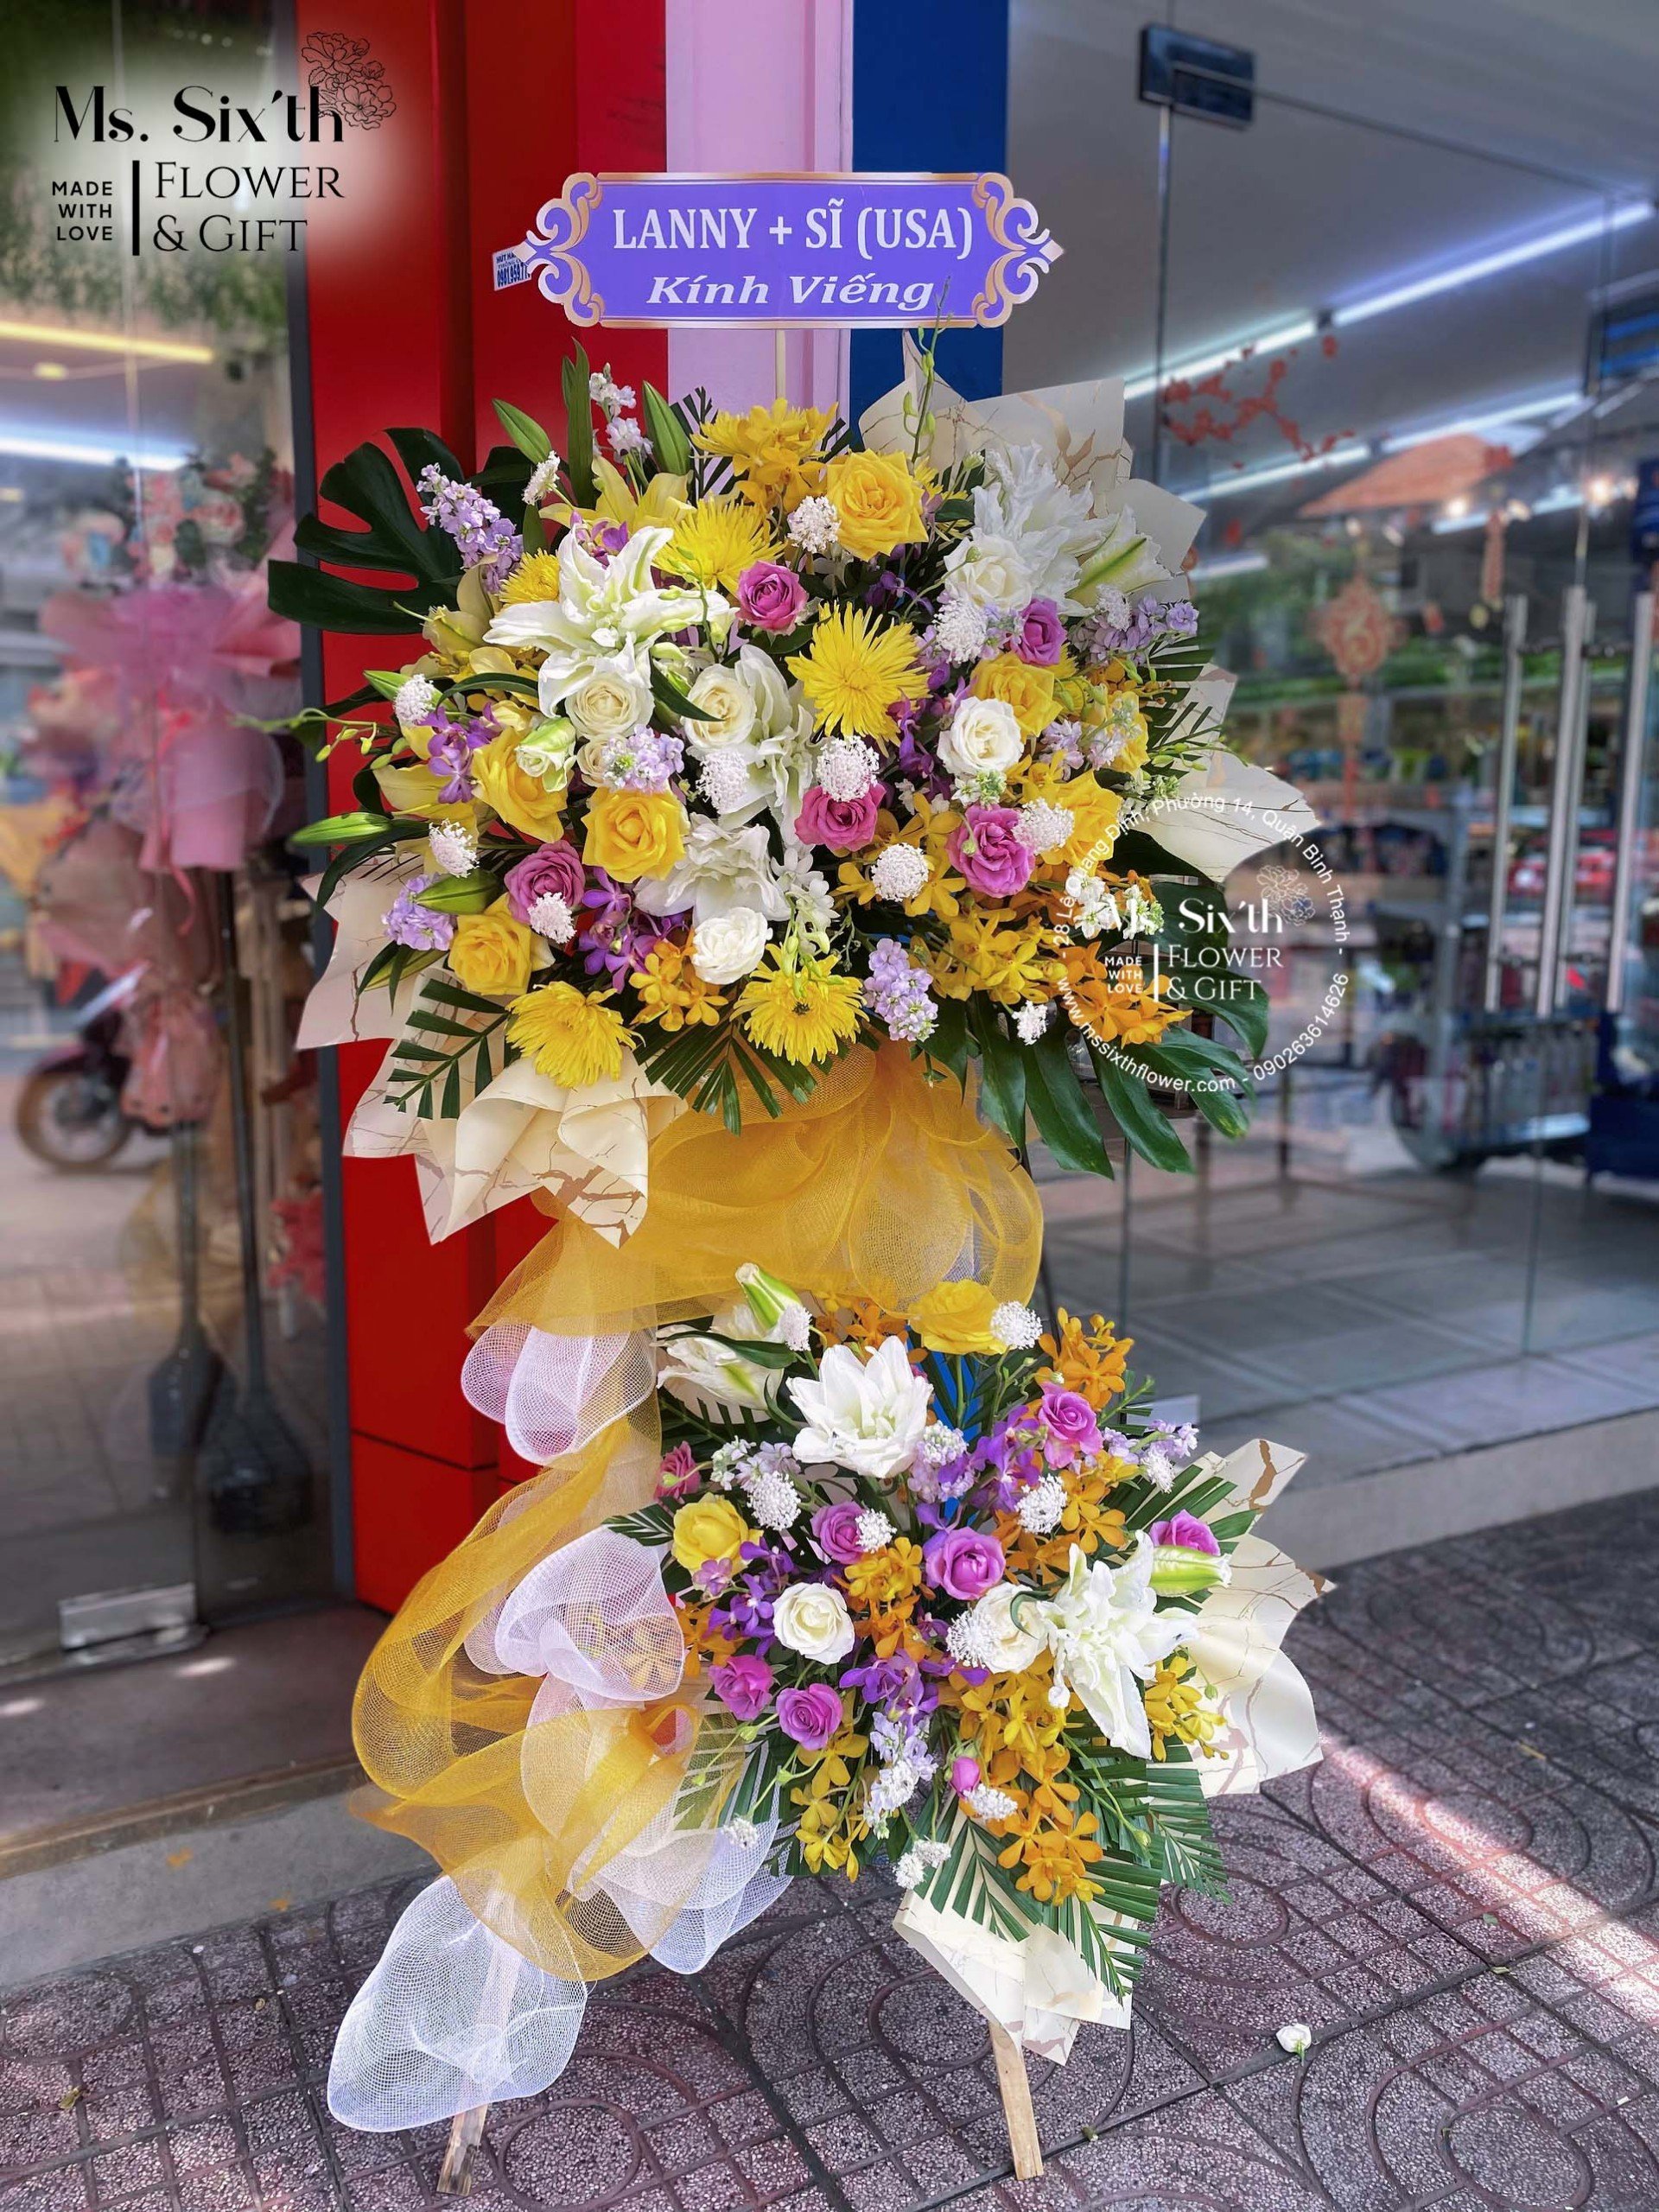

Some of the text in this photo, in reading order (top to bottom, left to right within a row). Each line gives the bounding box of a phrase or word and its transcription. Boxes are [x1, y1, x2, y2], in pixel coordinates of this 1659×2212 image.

[613, 198, 974, 260] LANNY + SĨ (USA)
[646, 274, 935, 311] Kính Viếng
